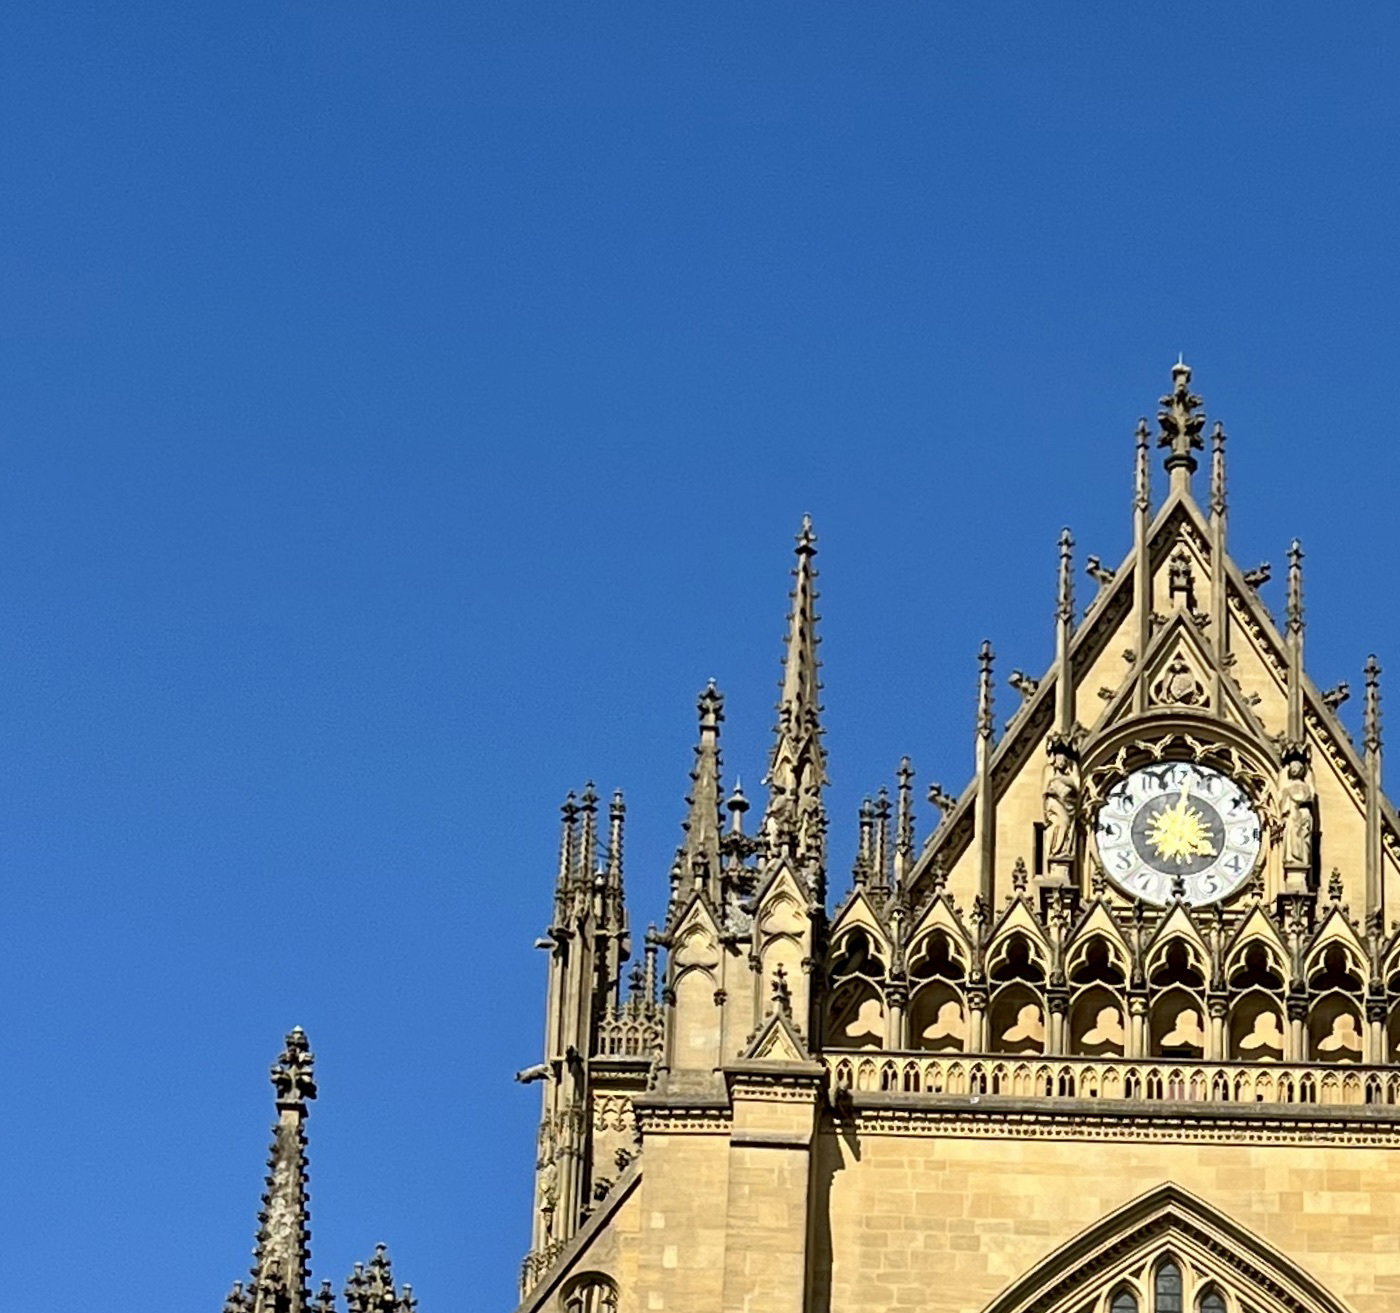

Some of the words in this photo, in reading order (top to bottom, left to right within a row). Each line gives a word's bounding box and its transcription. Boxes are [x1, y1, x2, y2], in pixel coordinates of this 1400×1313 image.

[1236, 827, 1250, 845] 3
[1116, 851, 1132, 870] 8
[1224, 854, 1242, 873] 4
[1137, 873, 1151, 890] 7
[1206, 875, 1218, 894] 5
